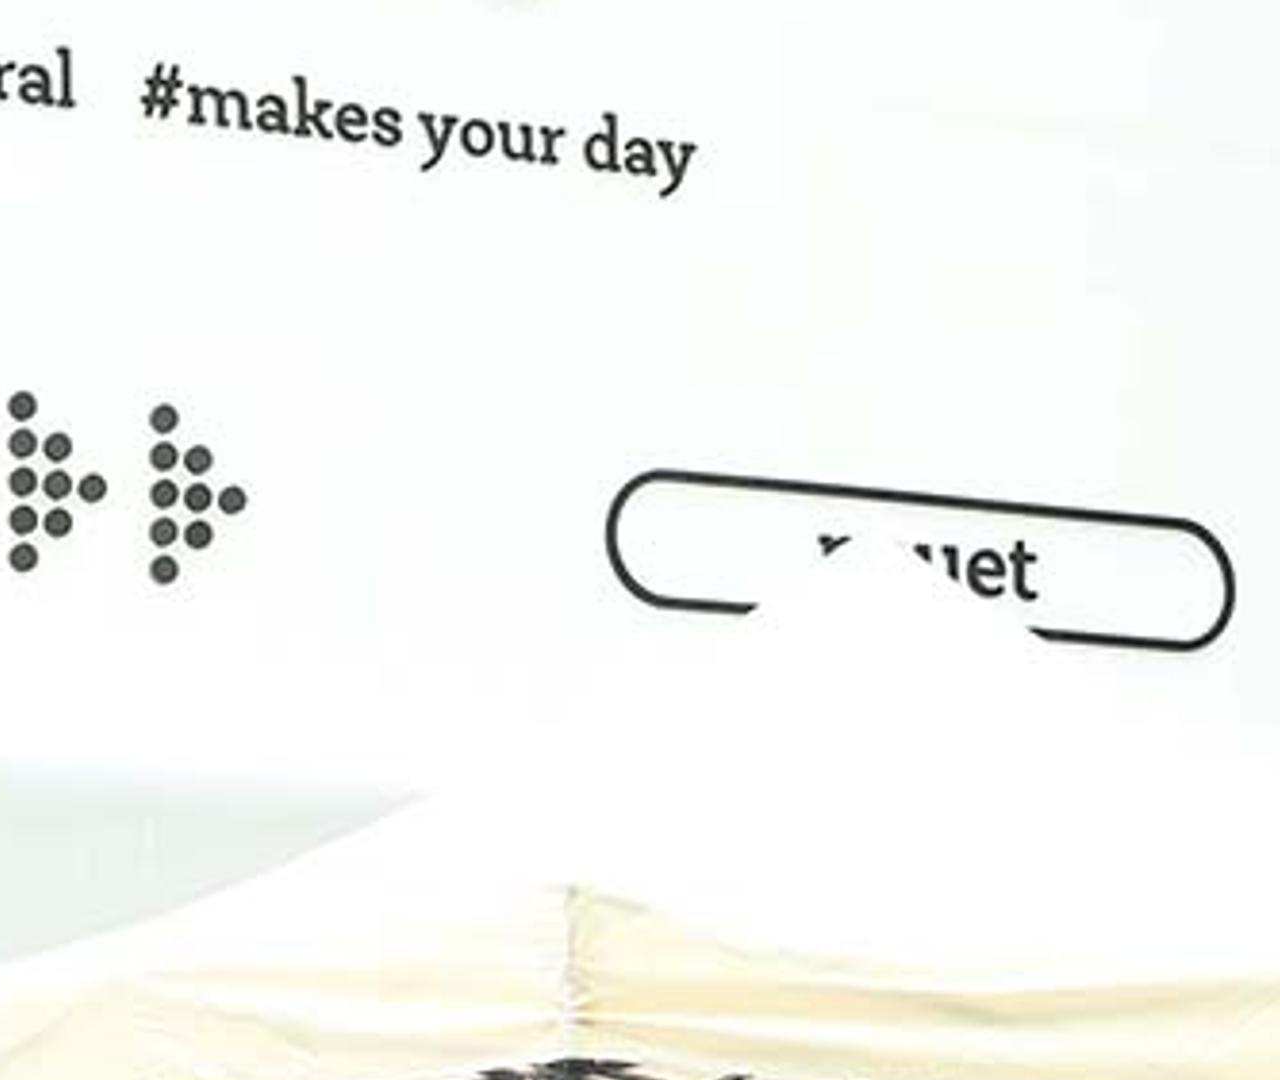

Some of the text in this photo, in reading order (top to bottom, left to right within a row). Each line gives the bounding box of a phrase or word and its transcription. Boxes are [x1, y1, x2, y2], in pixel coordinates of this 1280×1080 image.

[141, 62, 403, 146] #makes
[418, 111, 564, 171] your
[584, 113, 697, 197] day
